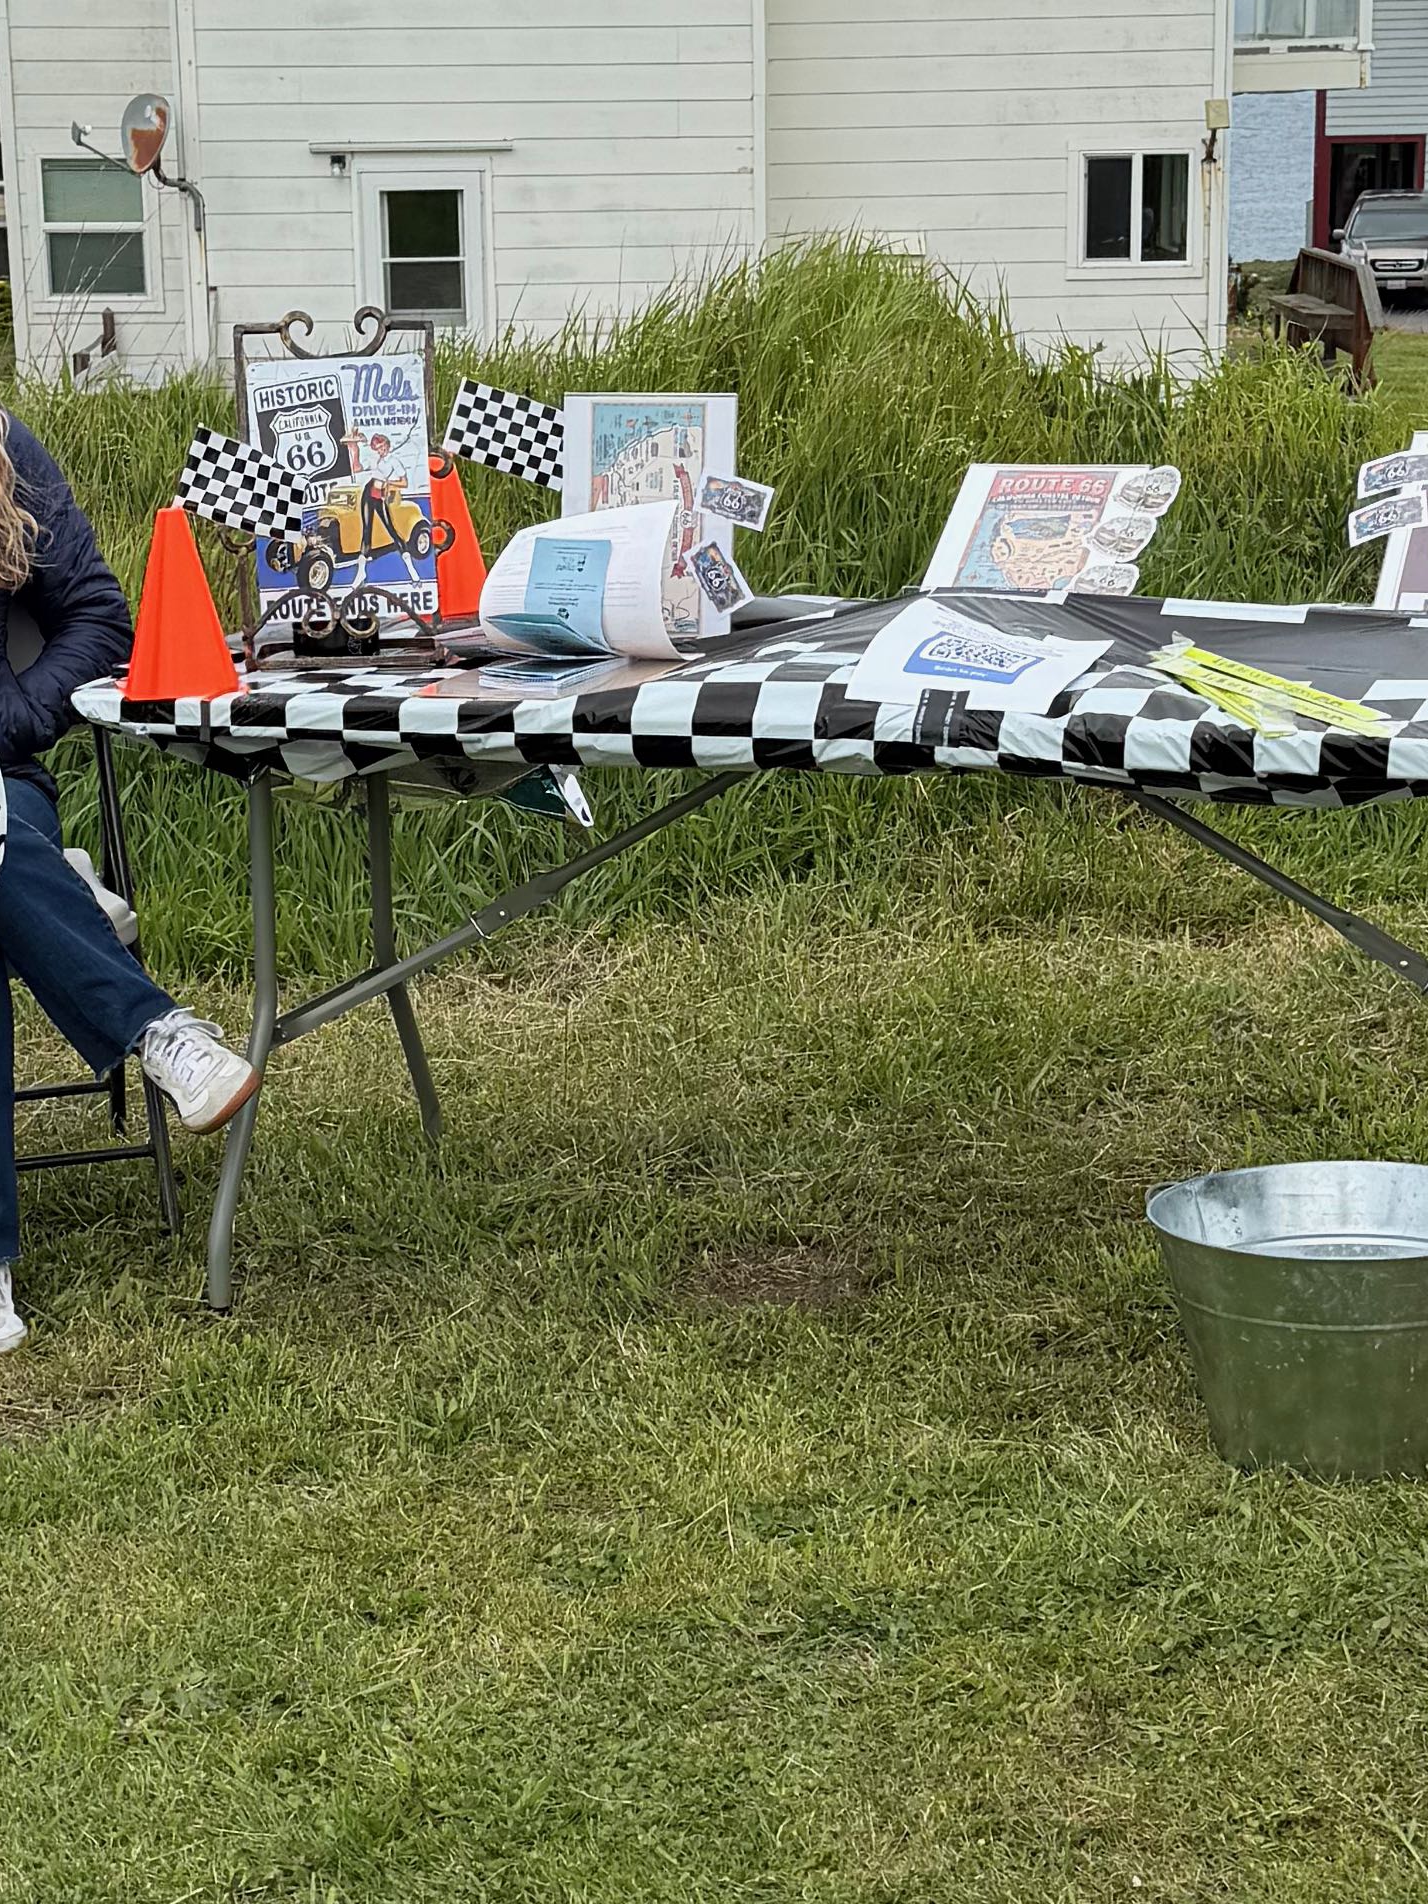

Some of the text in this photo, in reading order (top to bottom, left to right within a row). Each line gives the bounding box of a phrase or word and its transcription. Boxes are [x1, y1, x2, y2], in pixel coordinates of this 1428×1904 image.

[258, 378, 335, 410] HISTORIC
[286, 440, 327, 471] 66
[1386, 460, 1407, 479] 66
[999, 478, 1107, 494] ROUTE 66
[723, 492, 741, 510] 66
[266, 596, 328, 621] ROUTE
